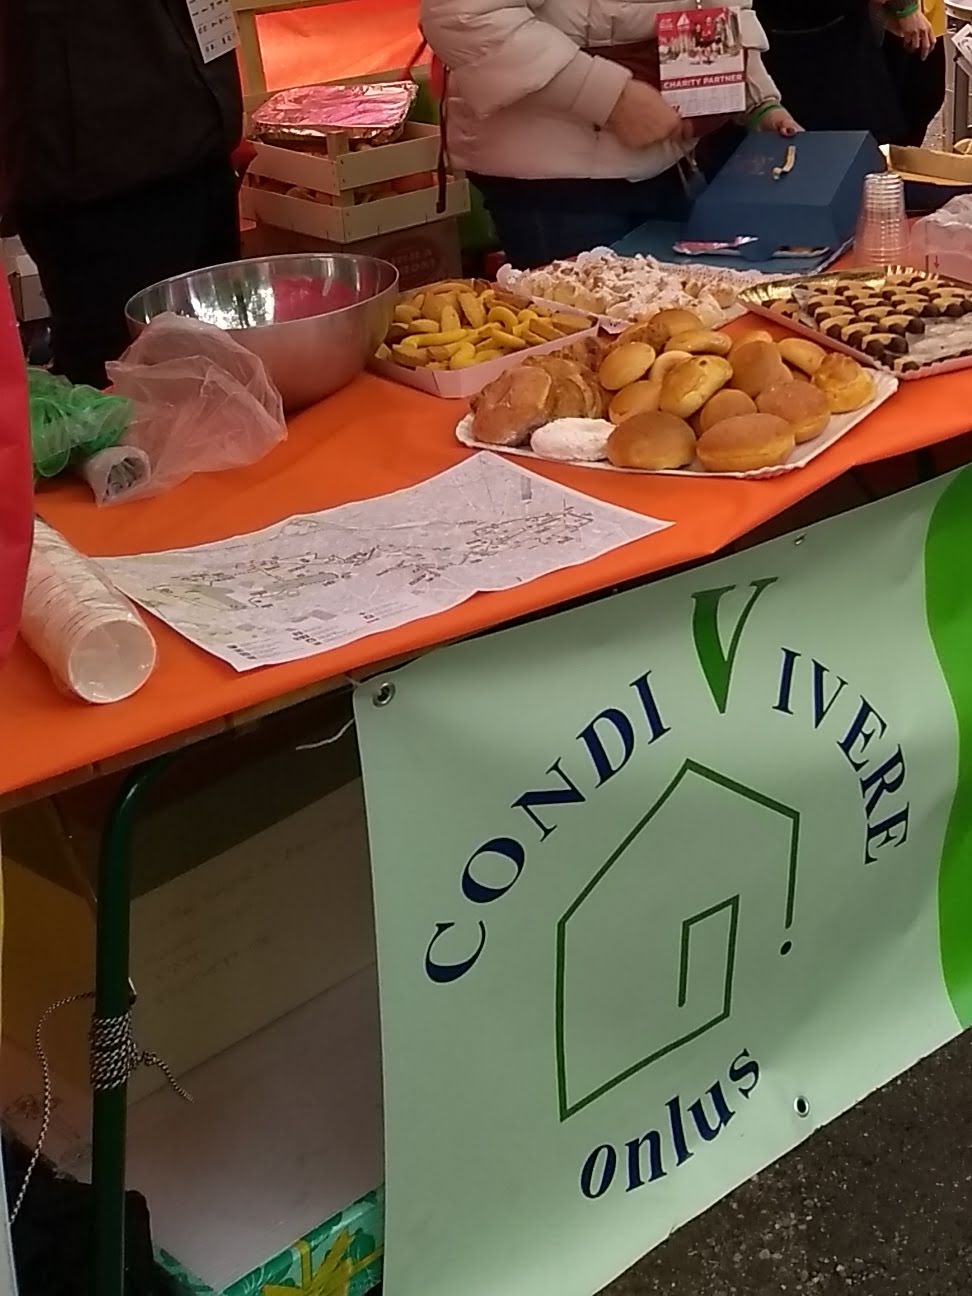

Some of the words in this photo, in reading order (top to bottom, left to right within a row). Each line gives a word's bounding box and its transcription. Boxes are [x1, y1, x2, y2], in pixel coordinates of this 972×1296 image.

[663, 78, 701, 90] CHARITY
[703, 74, 743, 85] PARTNER
[580, 1047, 760, 1199] onlus
